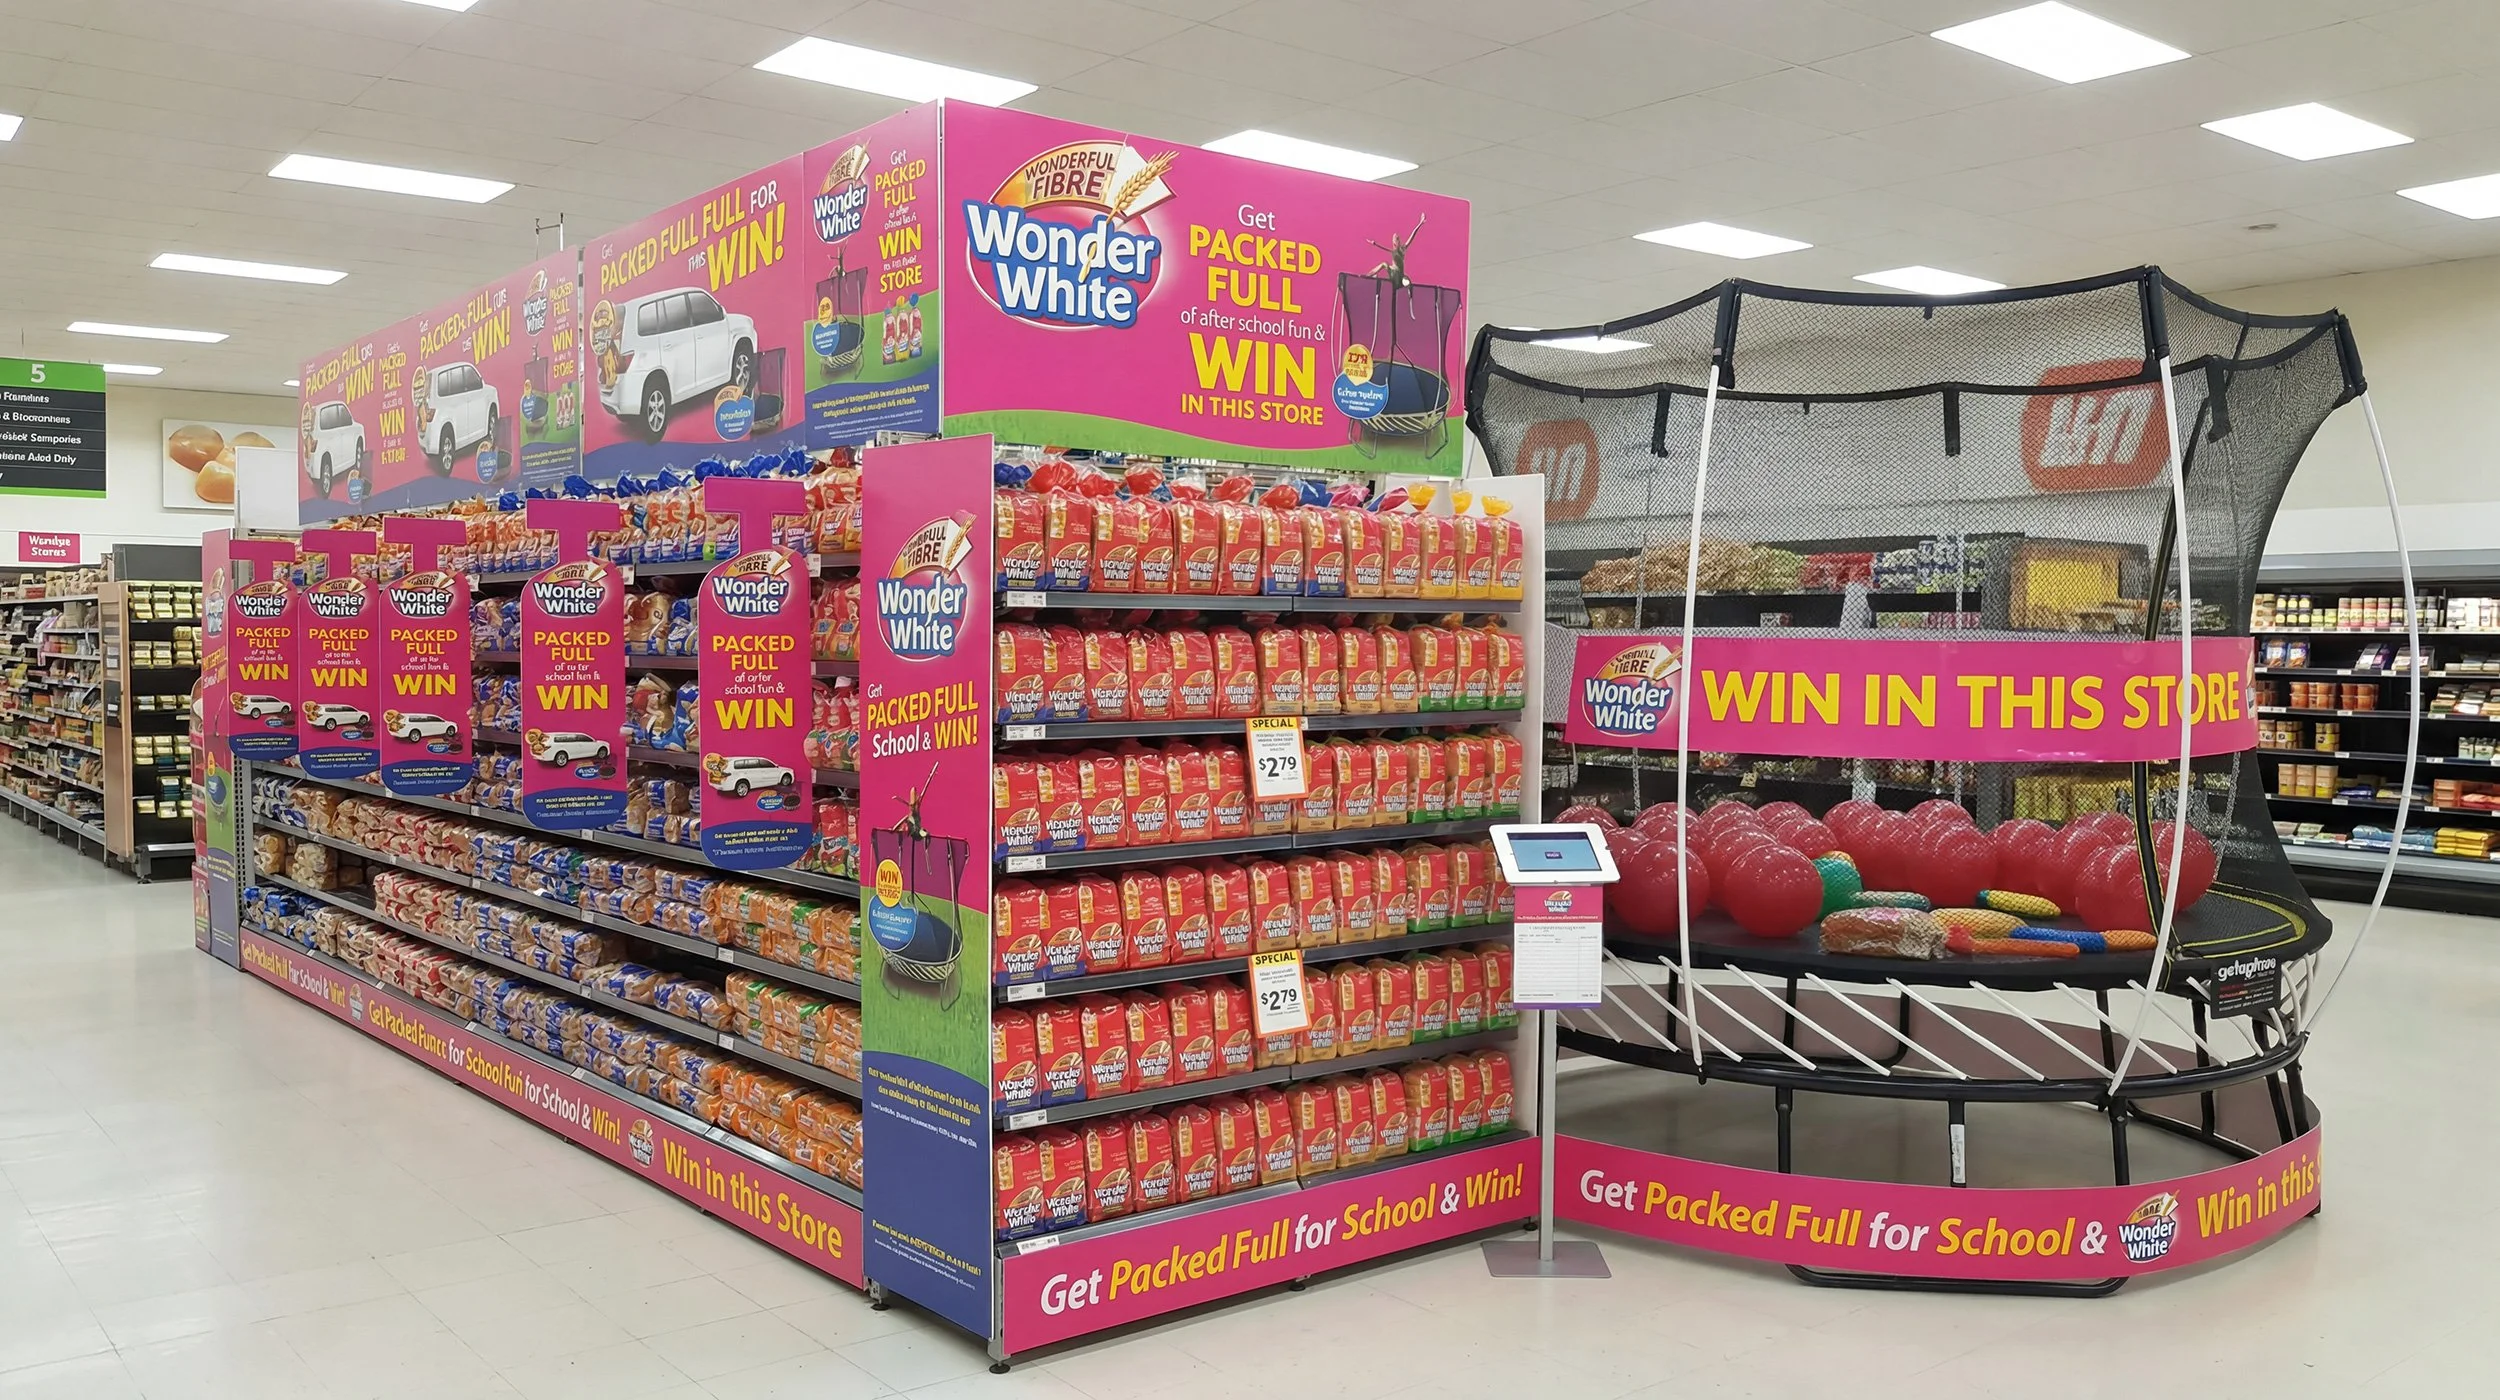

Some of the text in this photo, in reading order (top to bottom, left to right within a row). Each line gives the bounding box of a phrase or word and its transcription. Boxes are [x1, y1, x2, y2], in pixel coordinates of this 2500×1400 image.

[875, 159, 926, 192] PACKED
[1026, 151, 1115, 182] WONDERFUL
[884, 183, 917, 209] FULL
[1033, 171, 1104, 200] FIBRE
[814, 184, 867, 220] Wonder
[821, 211, 861, 239] White
[1238, 204, 1276, 231] Get
[600, 180, 777, 295] PACKED FULL FULL FOR
[707, 201, 786, 293] WIN!
[878, 224, 921, 260] WIN
[967, 204, 1155, 275] Wonder
[1190, 224, 1322, 275] PACKED
[880, 265, 923, 293] STORE
[996, 262, 1132, 321] White
[1207, 266, 1302, 314] FULL
[467, 290, 493, 328] FULL
[472, 305, 510, 365] WIN!
[1180, 307, 1326, 341] of after school fun &
[552, 328, 573, 353] WIN
[31, 364, 46, 383] 5
[305, 359, 340, 399] PACKED
[1189, 332, 1316, 400] WIN
[346, 359, 375, 405] WIN!
[379, 407, 404, 437] WIN
[1181, 393, 1324, 426] IN THIS STORE
[236, 595, 286, 606] Wonder
[309, 593, 364, 606] Wonder
[390, 588, 452, 604] Wonder
[534, 582, 603, 599] Wonder
[713, 577, 787, 598] Wonder
[878, 576, 964, 618] Wonder
[243, 605, 281, 616] White
[317, 604, 358, 616] White
[400, 602, 446, 615] White
[544, 599, 596, 614] White
[725, 596, 779, 613] White
[236, 627, 291, 638] PACKED
[249, 638, 280, 648] FULL
[309, 628, 369, 639] PACKED
[391, 629, 458, 641] PACKED
[534, 631, 611, 646] PACKED
[712, 635, 795, 652] PACKED
[890, 619, 952, 650] White
[322, 641, 357, 651] FULL
[406, 643, 445, 655] FULL
[551, 647, 595, 661] FULL
[239, 664, 288, 680] WIN
[731, 654, 778, 671] FULL
[311, 667, 368, 687] WIN
[392, 674, 456, 696] WIN
[545, 671, 574, 681] school
[725, 683, 756, 695] school
[536, 684, 609, 710] WIN
[867, 680, 979, 730] PACKED FULL
[1585, 679, 1670, 708] Wonder
[1701, 669, 2240, 729] WIN IN THIS STORE
[714, 698, 794, 730] WIN
[1252, 718, 1294, 729] SPECIAL
[1595, 705, 1656, 731] White
[873, 714, 978, 759] School & WIN!
[880, 869, 899, 884] WIN
[449, 1037, 464, 1067] for
[465, 1046, 503, 1084] School
[525, 1074, 542, 1105] for
[542, 1083, 580, 1125] School
[581, 1103, 591, 1131] &
[592, 1106, 621, 1145] Win!
[662, 1136, 701, 1190] Win
[705, 1157, 726, 1202] in
[731, 1171, 772, 1225] this
[777, 1192, 843, 1261] Store
[2197, 1186, 2251, 1238] Win
[2257, 1176, 2277, 1220] in
[2281, 1154, 2314, 1207] this
[1579, 1169, 2107, 1258] Get Packed Full for School &
[1041, 1163, 1525, 1317] Get Packed Full for School & Win!
[2119, 1219, 2175, 1243] Wonder
[2127, 1239, 2168, 1260] White
